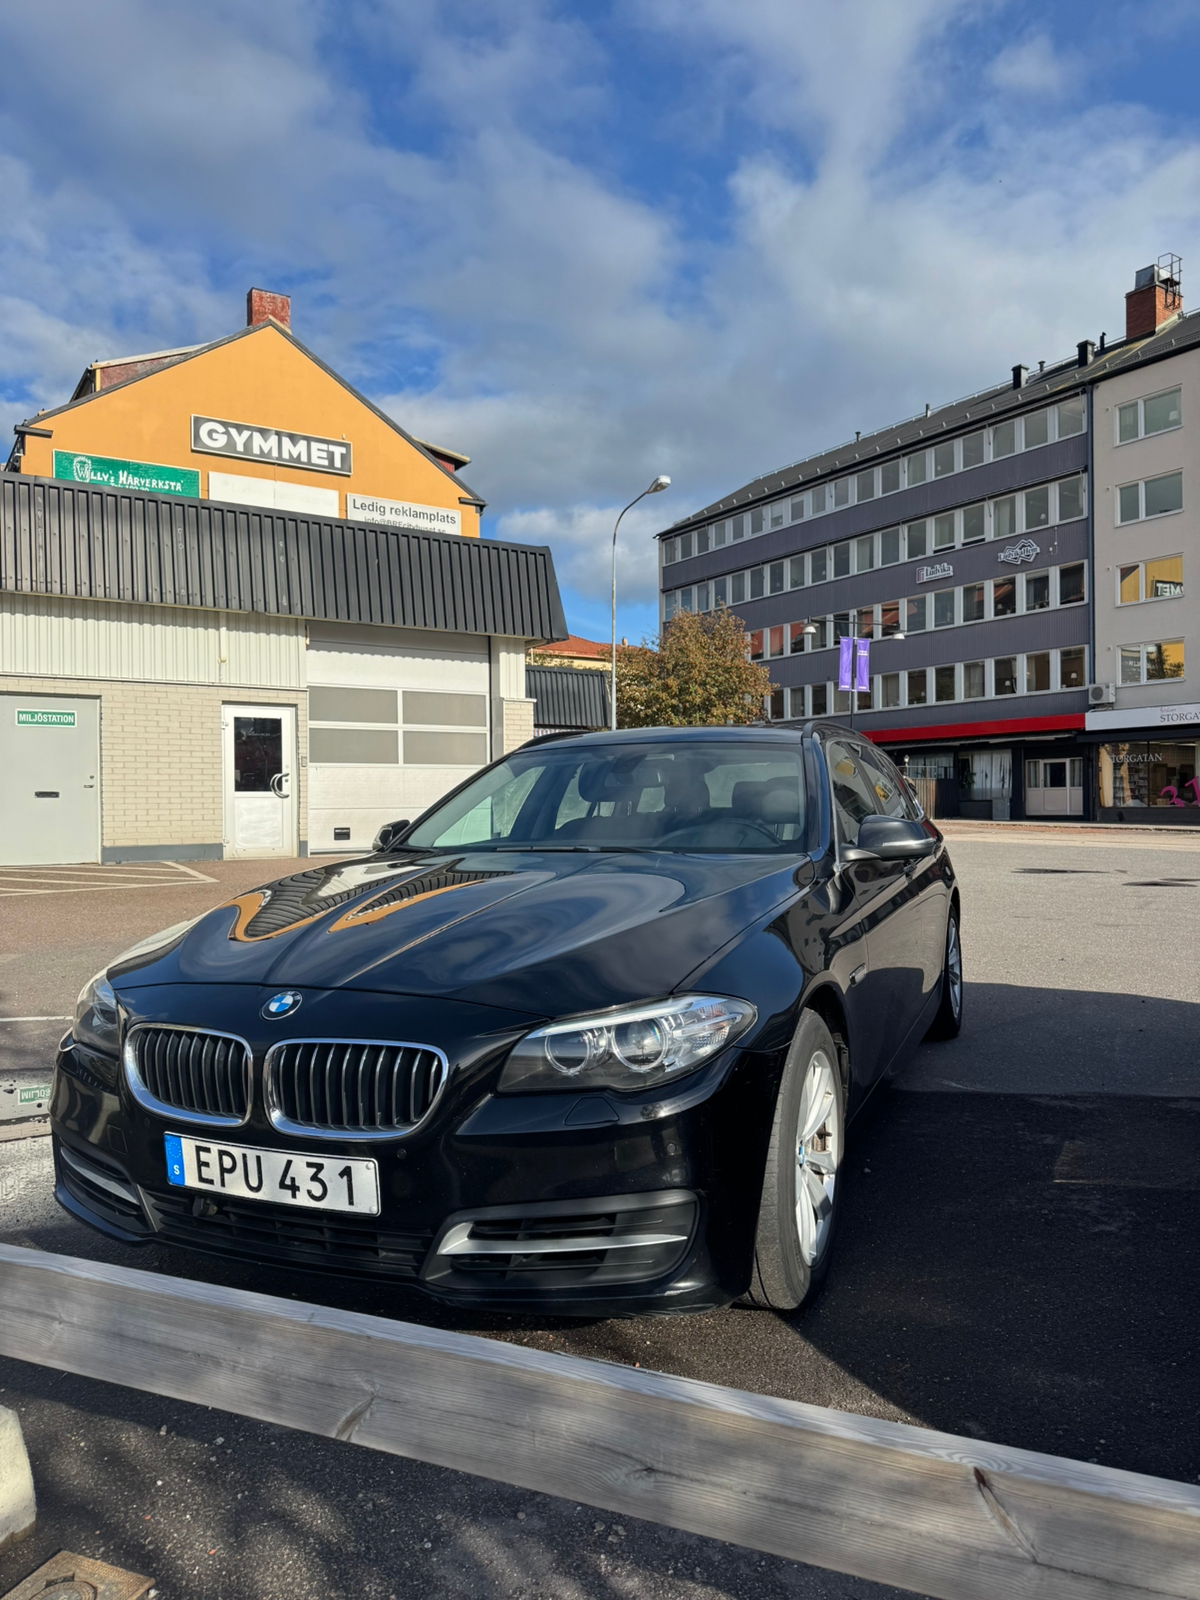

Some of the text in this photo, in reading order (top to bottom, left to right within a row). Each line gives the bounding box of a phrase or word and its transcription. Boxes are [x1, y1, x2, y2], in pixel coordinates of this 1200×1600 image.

[199, 421, 347, 468] GYMMET
[353, 499, 456, 524] Ledig reklamplats
[19, 713, 74, 723] MILJÖSTATION
[1160, 712, 1200, 723] STORGA
[173, 1164, 180, 1175] S
[195, 1145, 354, 1206] EPU 431
